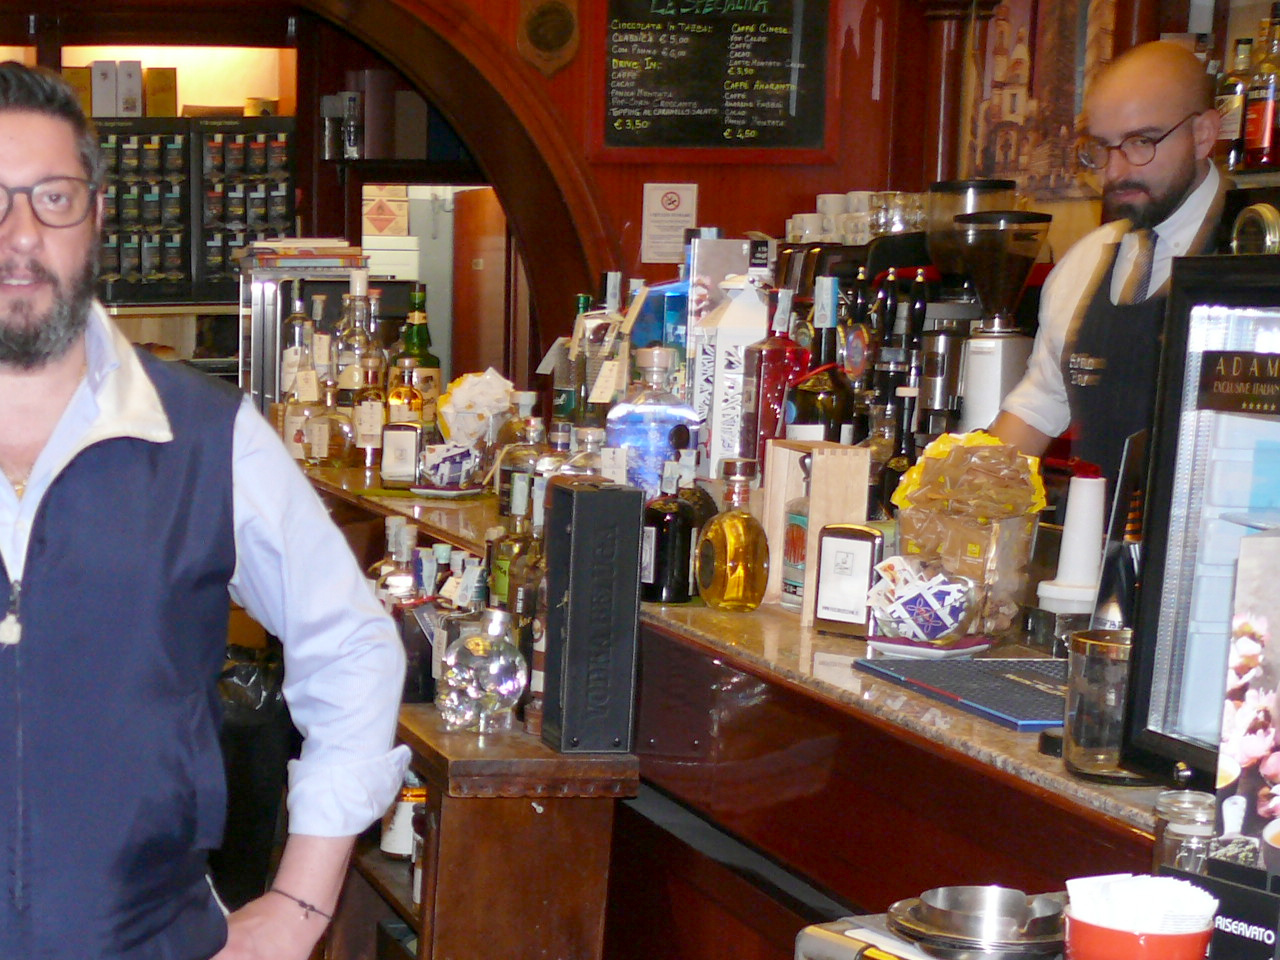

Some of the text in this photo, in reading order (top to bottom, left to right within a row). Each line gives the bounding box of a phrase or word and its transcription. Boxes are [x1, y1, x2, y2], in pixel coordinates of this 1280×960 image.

[612, 58, 640, 70] DRIVE
[610, 107, 640, 116] TOPPING
[625, 120, 649, 131] 3,50
[1213, 380, 1251, 395] EXCLUSIVE
[1215, 915, 1275, 945] RISERVATO
